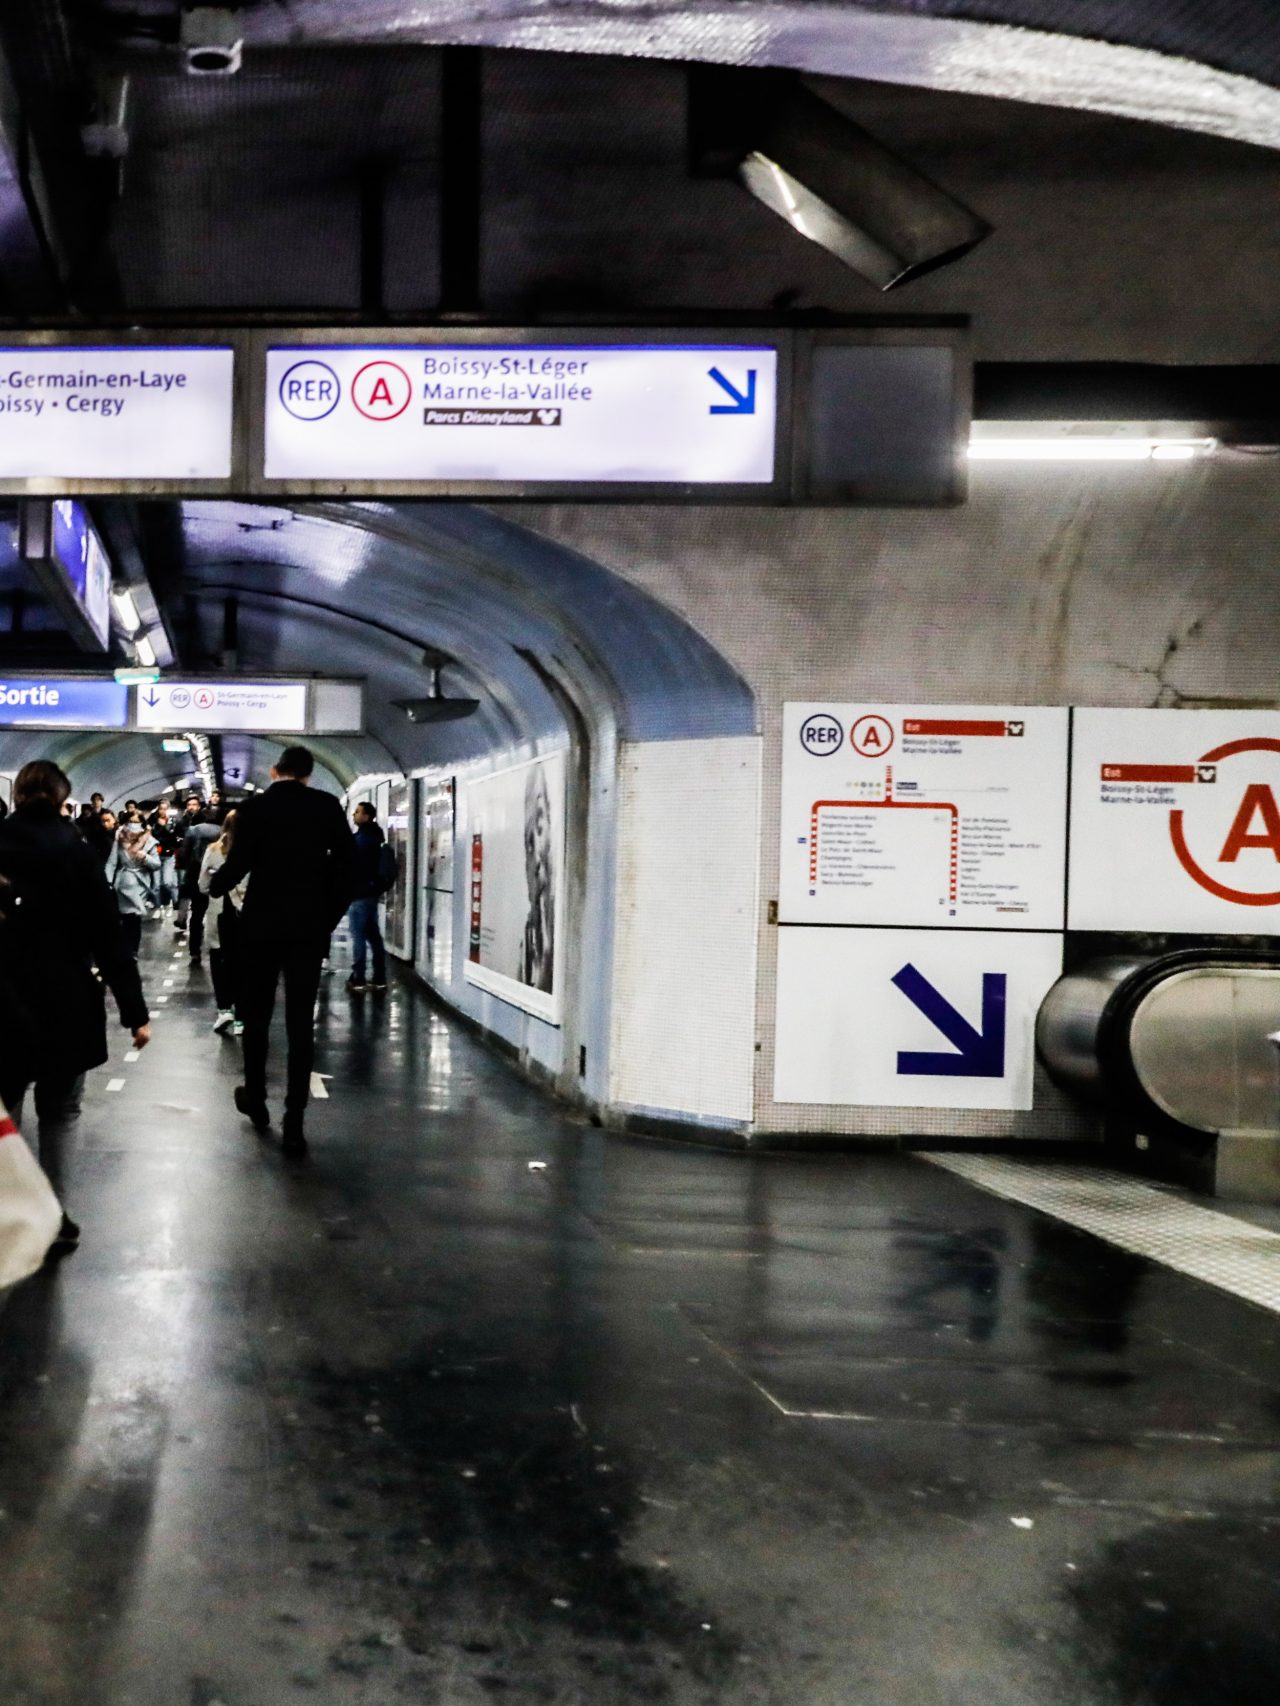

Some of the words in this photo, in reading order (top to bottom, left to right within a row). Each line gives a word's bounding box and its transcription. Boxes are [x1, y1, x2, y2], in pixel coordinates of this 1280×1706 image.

[424, 357, 588, 377] Boissy-St-Léger
[288, 380, 332, 401] RER
[368, 378, 393, 406] A
[423, 382, 593, 401] Marne-la-Vallée
[66, 395, 125, 416] Cergy
[426, 410, 459, 424] Parcs
[462, 409, 532, 426] Disneyland
[173, 693, 188, 701] RER
[199, 694, 208, 704] A
[806, 727, 837, 743] RER
[862, 726, 881, 747] A
[1218, 784, 1280, 862] A
